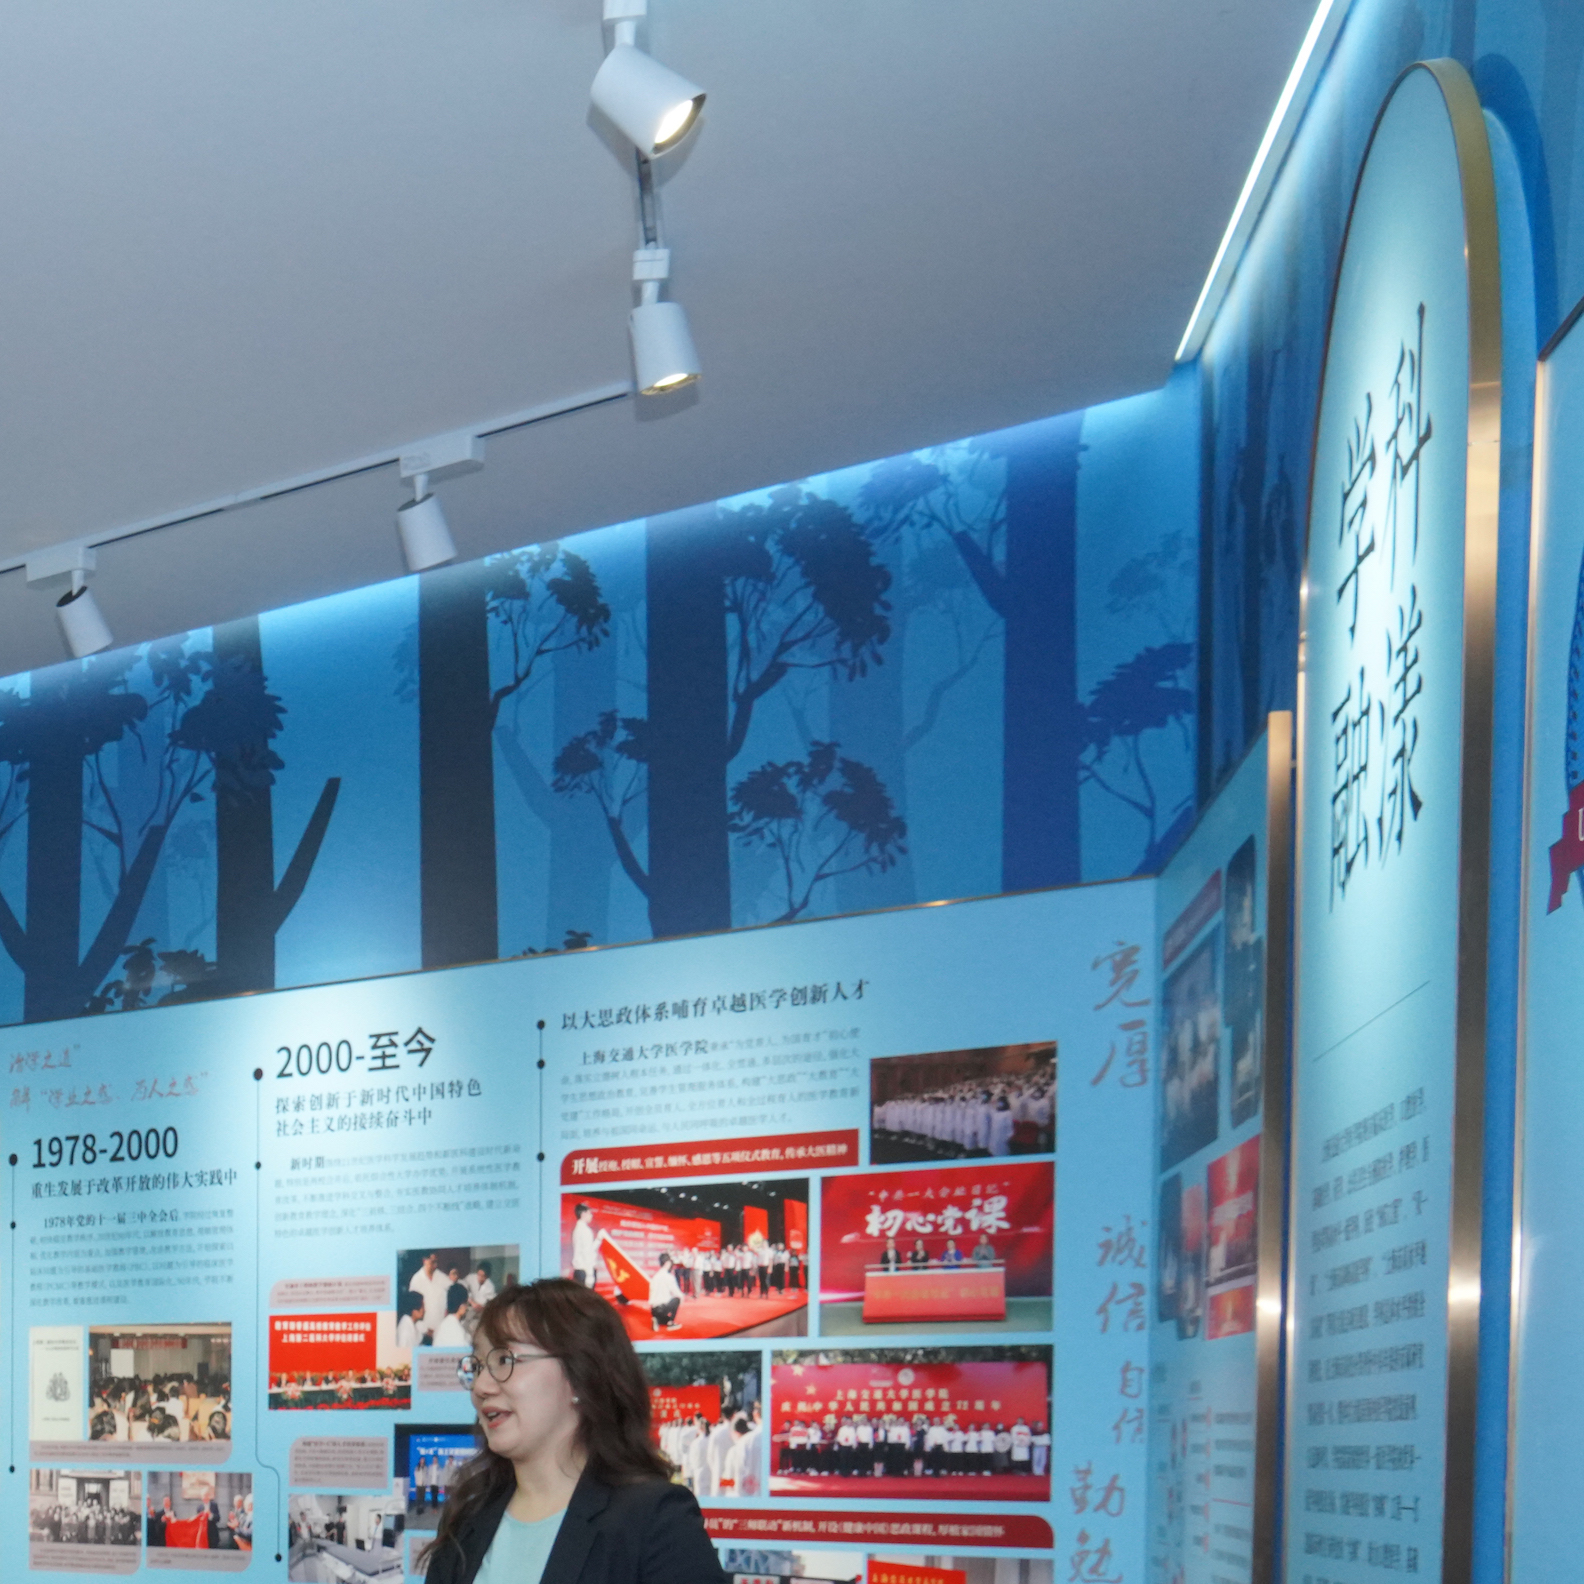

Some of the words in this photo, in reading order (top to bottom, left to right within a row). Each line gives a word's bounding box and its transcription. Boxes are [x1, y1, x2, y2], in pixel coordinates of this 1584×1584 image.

[1338, 301, 1432, 650] 学科
[561, 978, 869, 1031] 以大思政体系哺育卓越医学创新人才
[275, 1026, 436, 1079] 2000-至今
[275, 1078, 482, 1114] 探索创新于新时代中国特色
[276, 1107, 432, 1137] 社会主义的接续奋斗中
[32, 1126, 179, 1169] 1978-2000
[32, 1168, 237, 1199] 重生发展于改革开放的伟大实践中
[865, 1195, 1011, 1237] 初心党课
